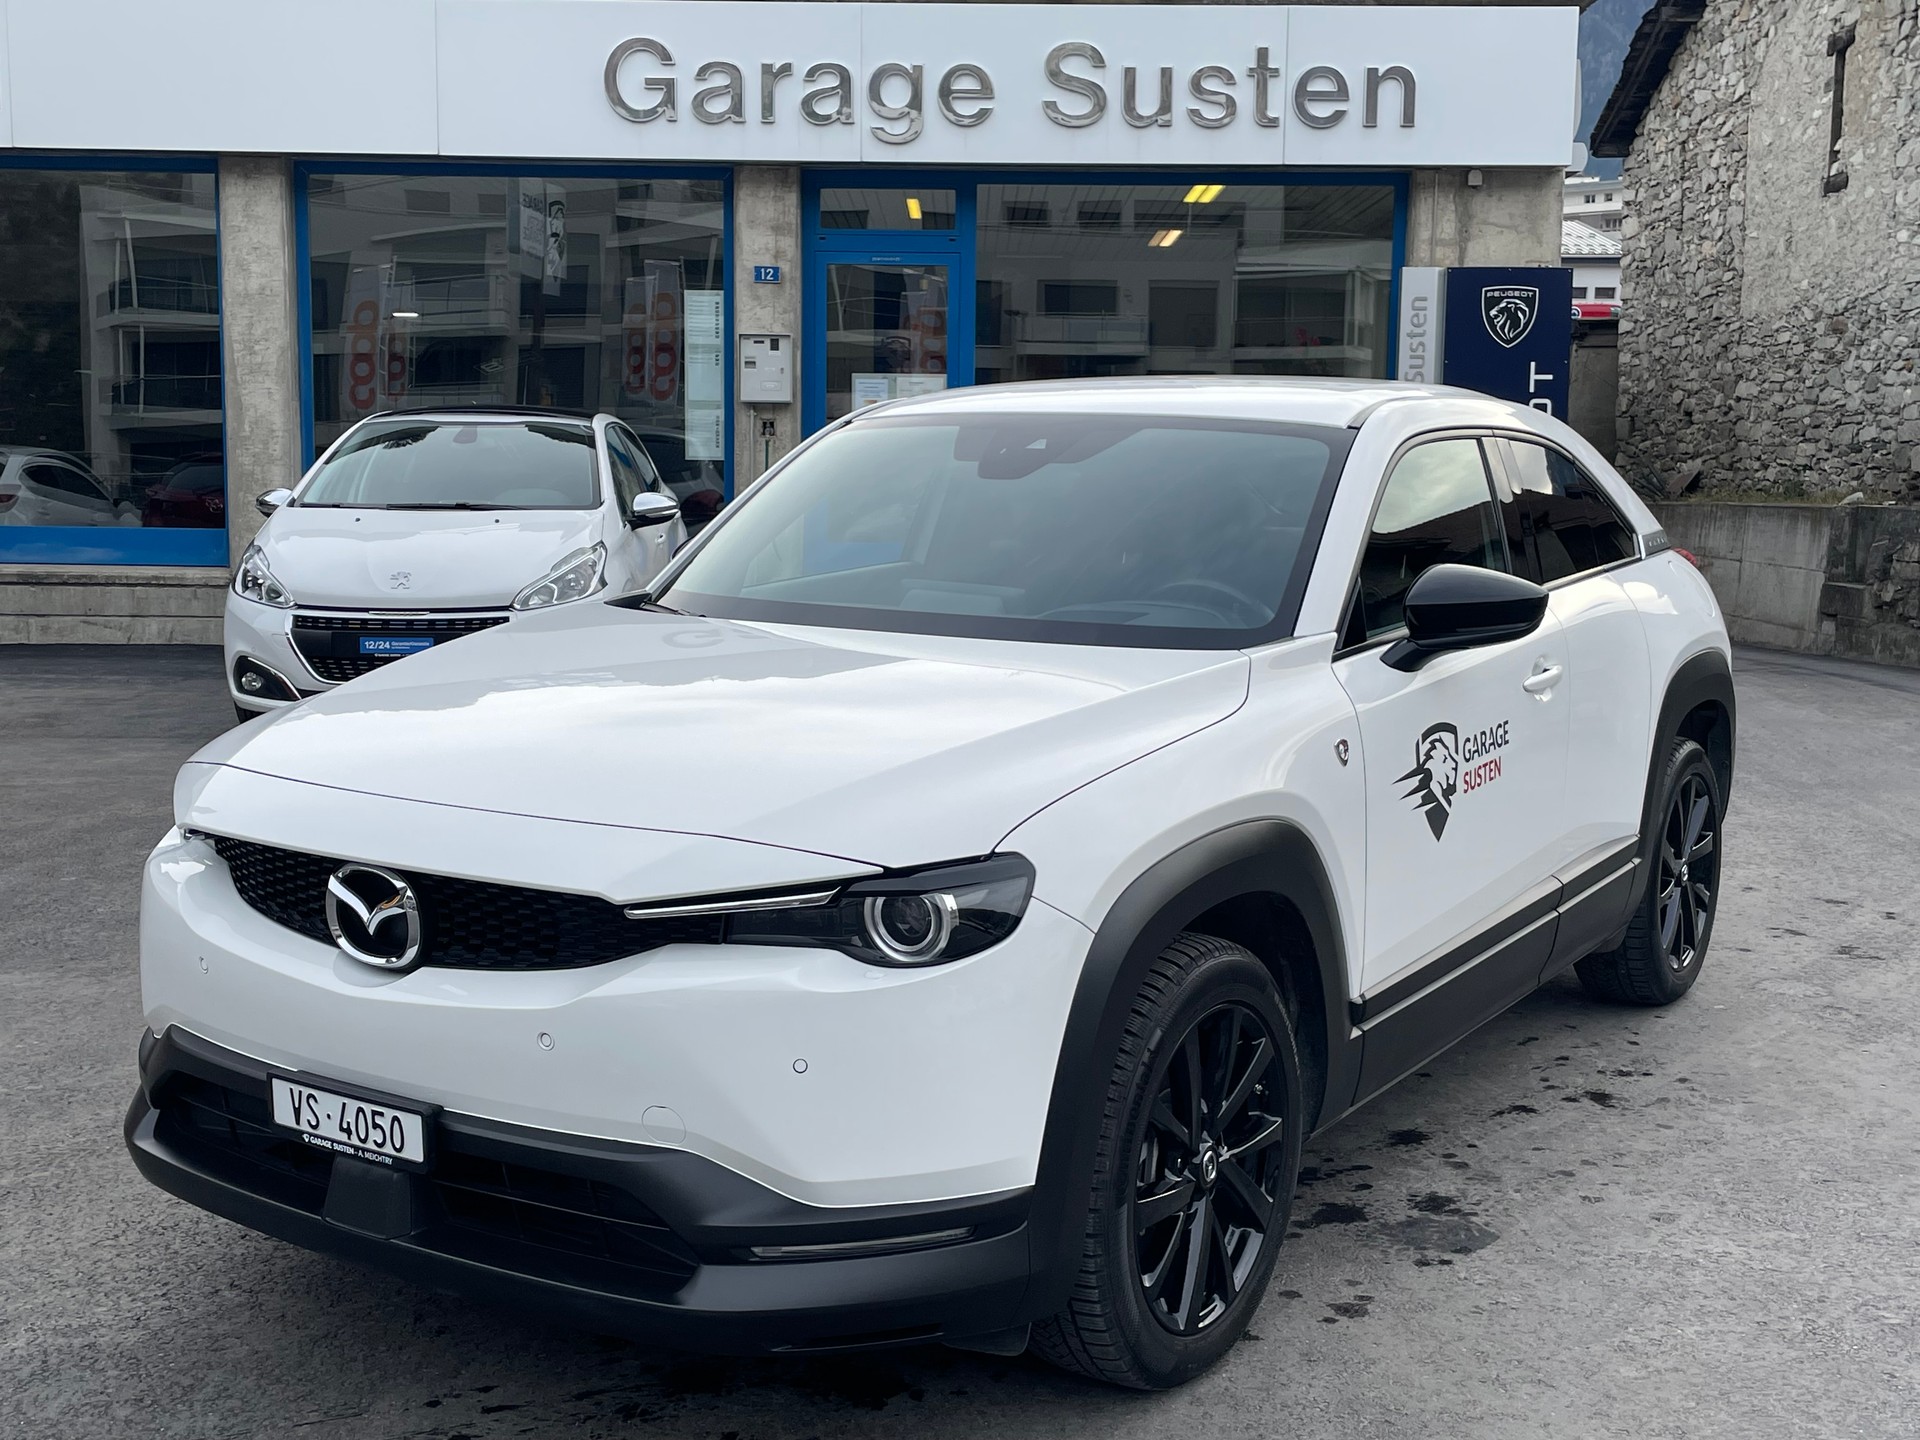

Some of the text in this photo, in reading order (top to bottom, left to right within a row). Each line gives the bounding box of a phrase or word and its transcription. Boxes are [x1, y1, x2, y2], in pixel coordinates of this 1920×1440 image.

[603, 36, 1418, 145] Garage Susten
[760, 268, 774, 281] 12
[1486, 290, 1534, 298] PEUGEOT
[364, 640, 391, 650] 12/24
[1462, 720, 1510, 763] GARAGE
[1463, 756, 1502, 794] SUSTEN
[310, 1135, 333, 1149] GARAGE
[333, 1142, 355, 1155] SUSTEN
